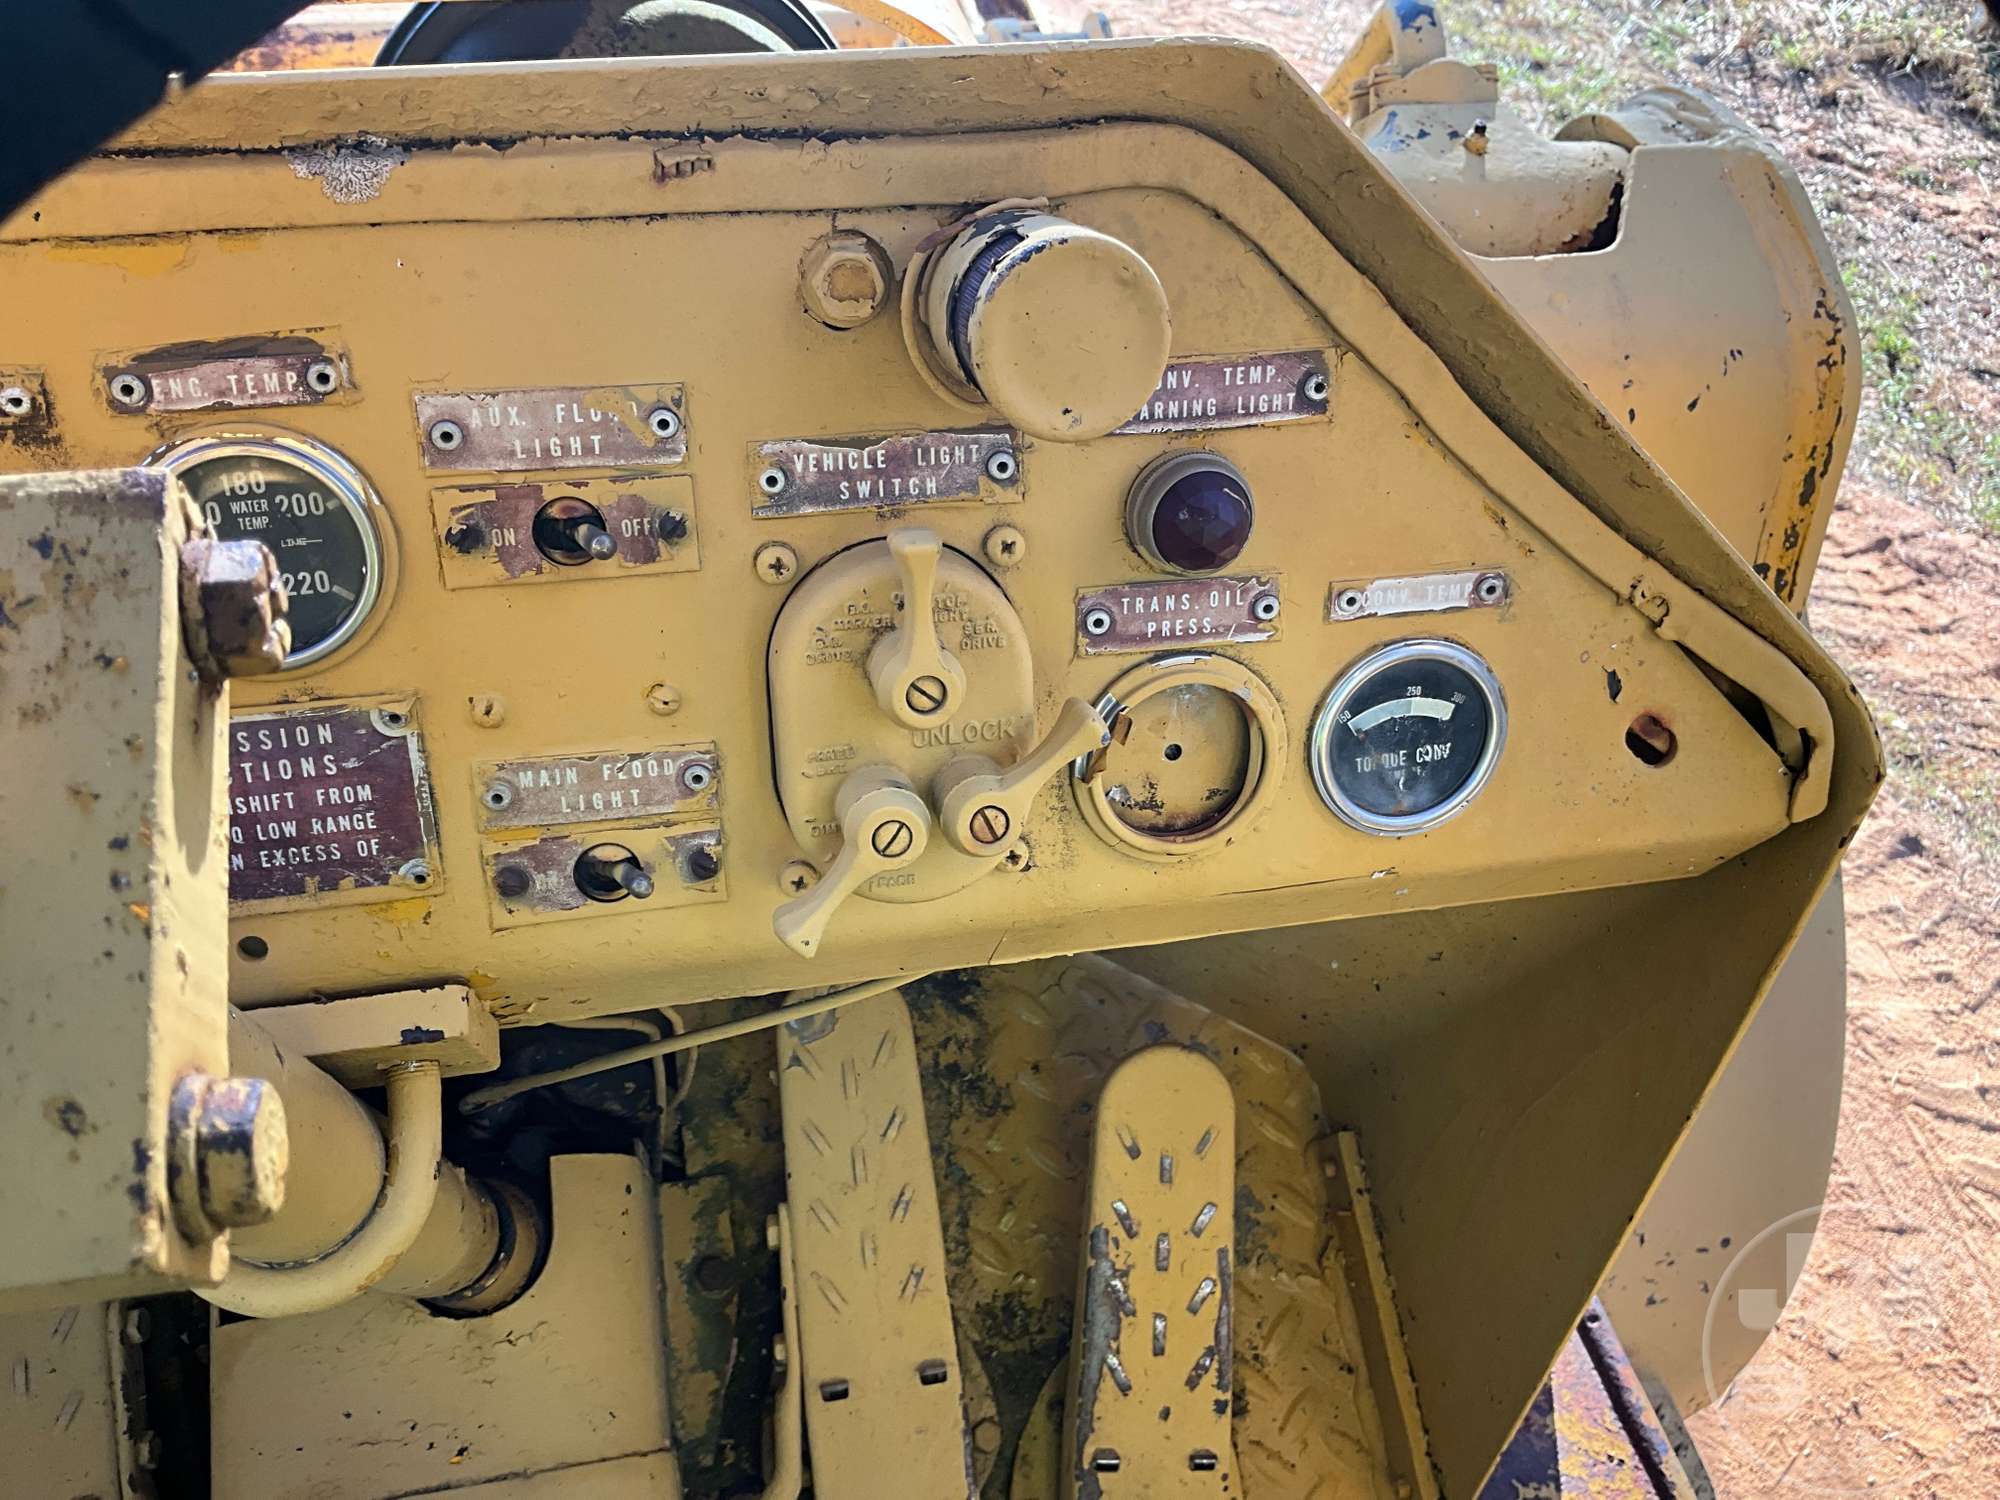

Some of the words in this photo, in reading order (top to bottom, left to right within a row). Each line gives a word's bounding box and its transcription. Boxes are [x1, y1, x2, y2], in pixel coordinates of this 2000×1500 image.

[151, 378, 209, 399] ENG.
[226, 371, 304, 395] TEMP.
[1156, 370, 1200, 390] NV.
[1223, 365, 1282, 386] TEMP.
[470, 405, 526, 429] AUX.
[1138, 398, 1217, 421] ARNING
[1237, 392, 1296, 414] LIGHT
[514, 435, 602, 459] LIGHT
[793, 449, 887, 473] VEHICLE
[917, 444, 980, 466] LIGHT
[219, 470, 266, 497] 180
[839, 477, 937, 500] SWITCH
[229, 498, 270, 515] WATER
[274, 491, 325, 518] 200
[237, 516, 273, 531] TEMP.
[491, 527, 516, 548] ON
[621, 517, 651, 538] OFF
[282, 570, 330, 596] 220
[1121, 592, 1200, 615] TRANS.
[1209, 588, 1245, 609] OIL
[1146, 616, 1217, 639] PRESS.
[1406, 685, 1422, 697] 250
[1337, 710, 1352, 725] 150
[237, 723, 333, 752] SSION
[912, 718, 1016, 749] UNLOCK
[229, 754, 337, 784] TIONS
[519, 767, 578, 789] MAIN
[602, 758, 674, 782] FLOOD
[316, 784, 373, 806] FROM
[561, 789, 640, 813] LIGHT
[256, 821, 297, 841] LOW
[312, 812, 377, 835] RANGE
[260, 843, 341, 868] EXCESS
[357, 839, 379, 857] OF
